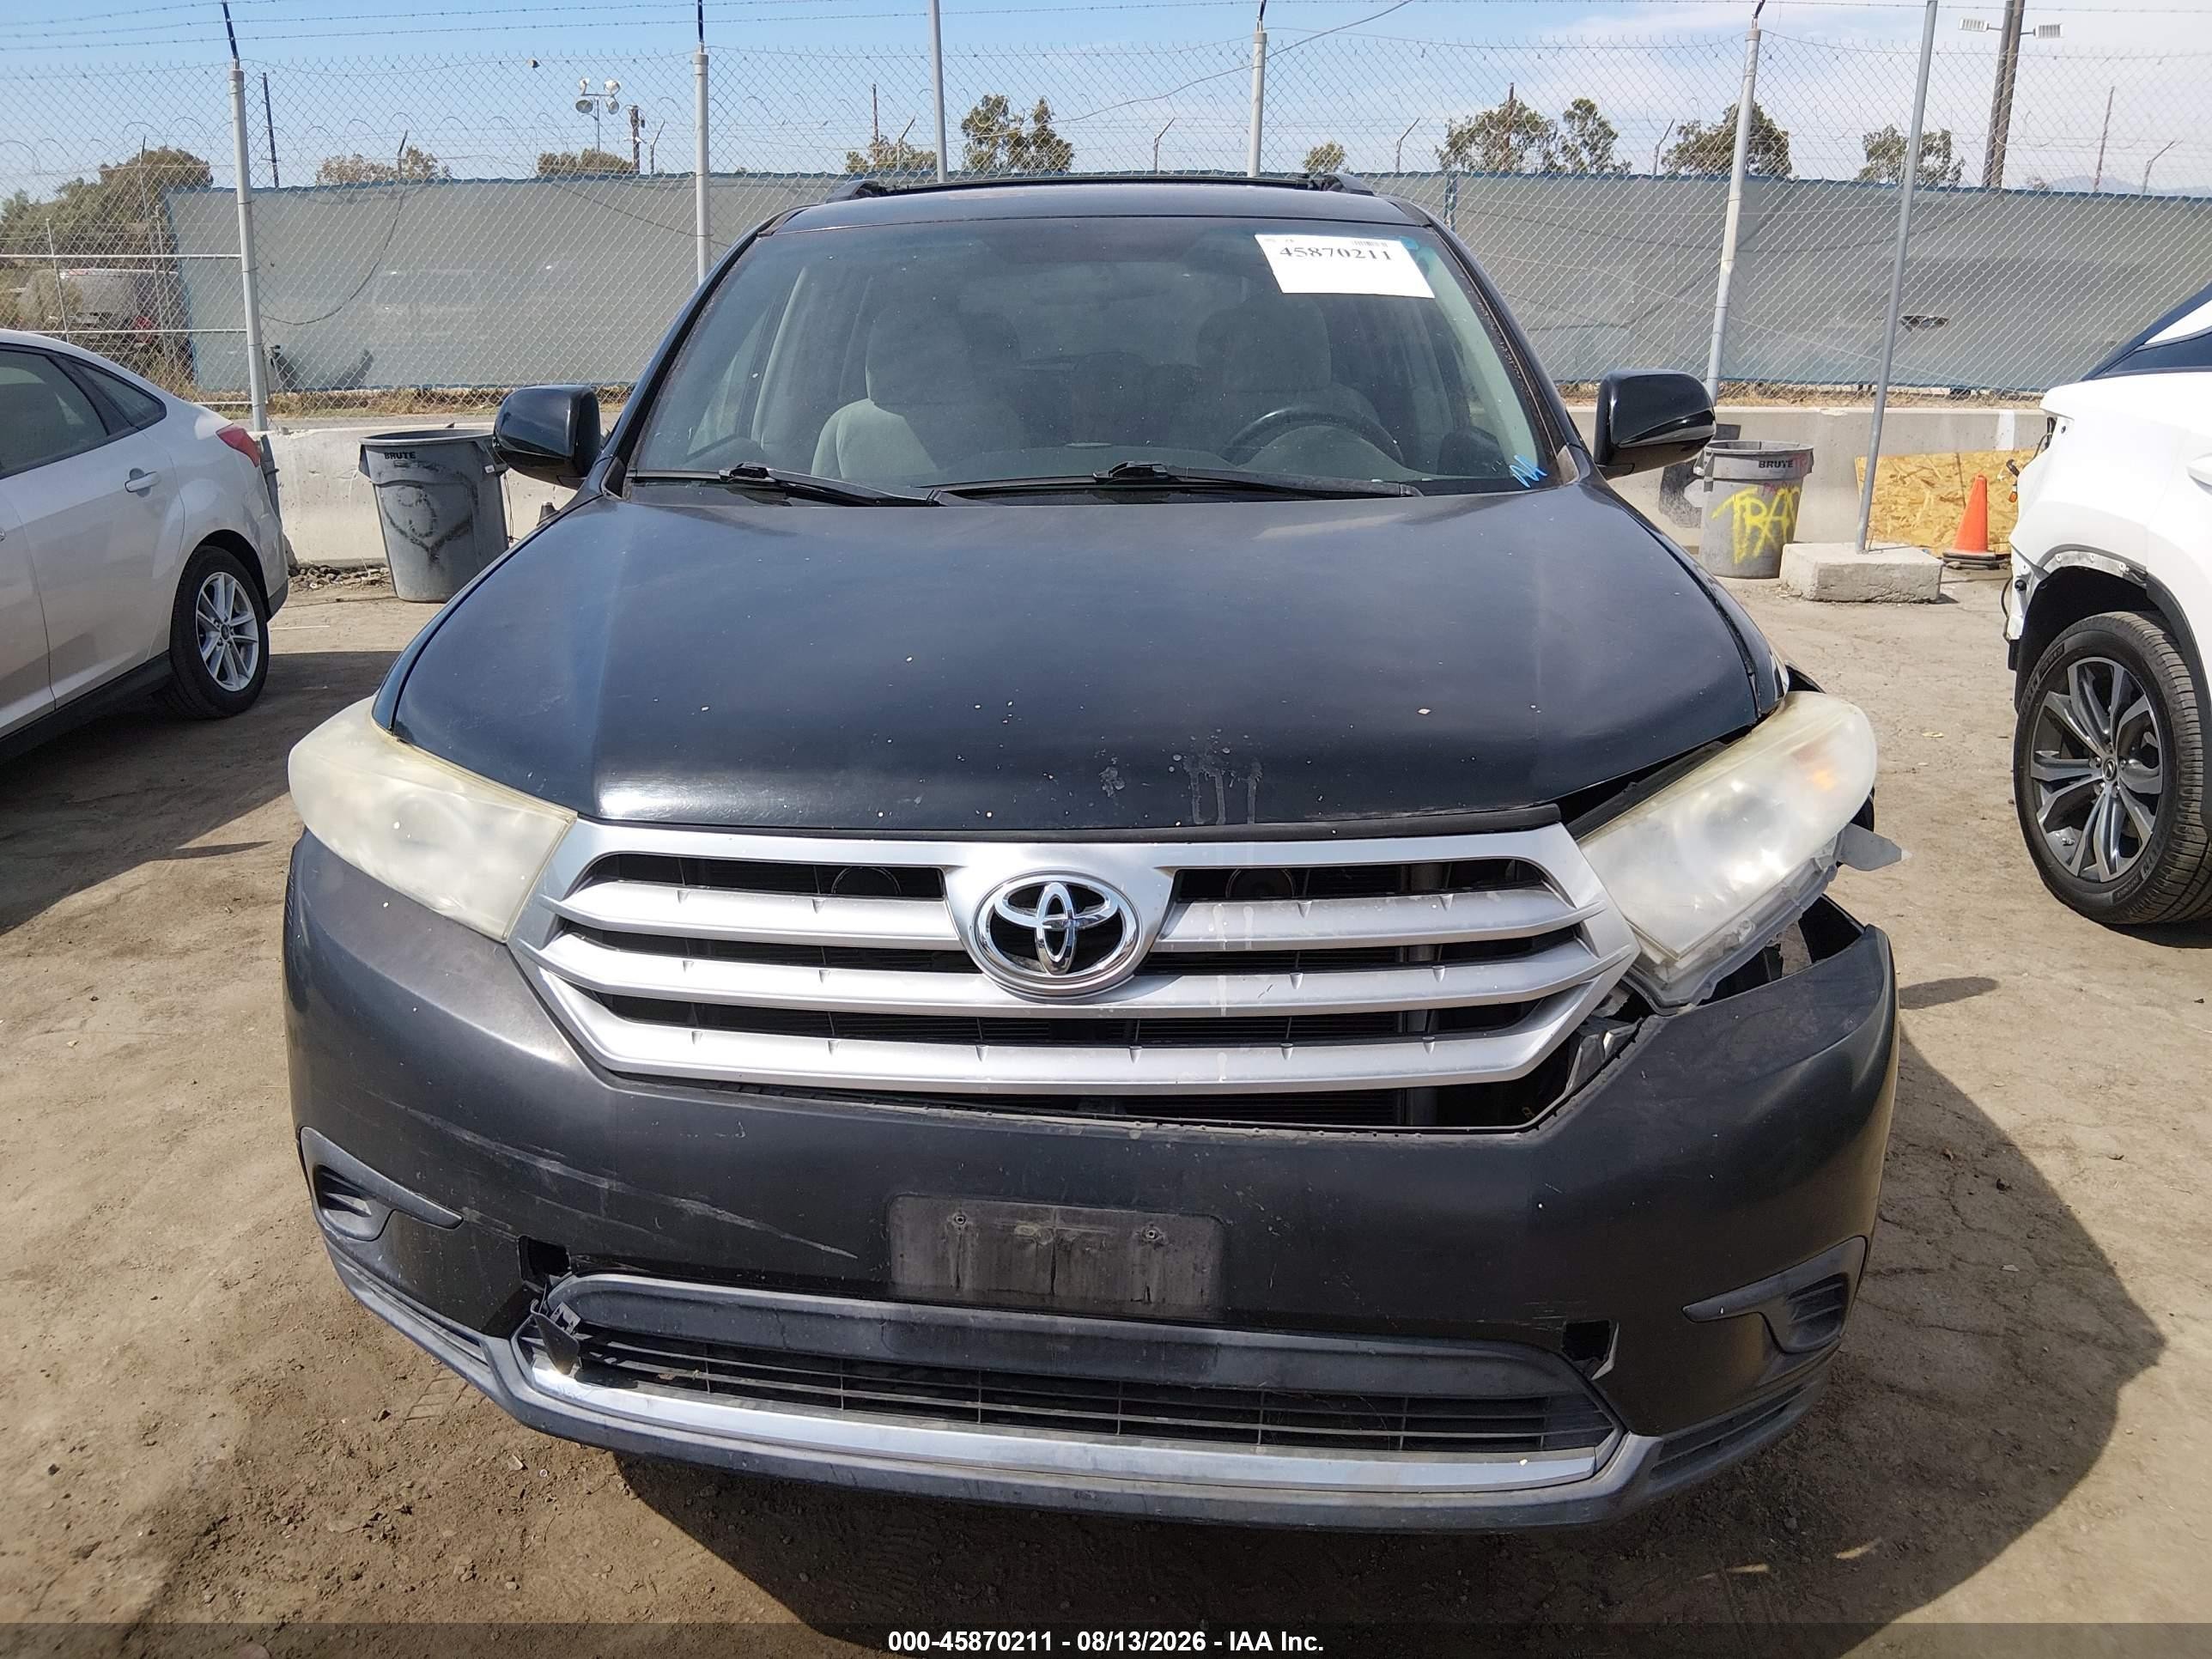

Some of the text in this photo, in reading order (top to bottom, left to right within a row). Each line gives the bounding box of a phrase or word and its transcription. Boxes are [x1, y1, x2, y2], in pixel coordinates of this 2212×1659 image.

[1279, 246, 1392, 261] 45870211
[384, 451, 416, 460] BRUTE
[1758, 459, 1794, 469] BRUTE
